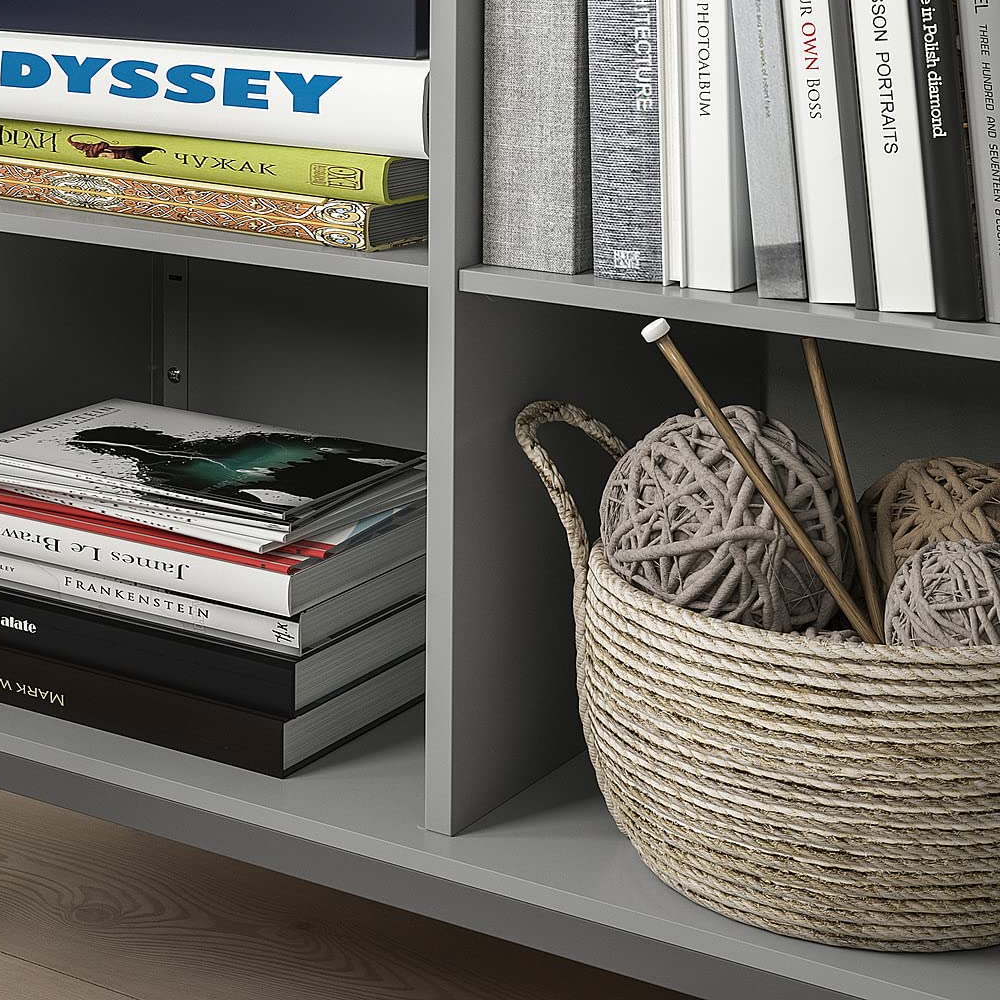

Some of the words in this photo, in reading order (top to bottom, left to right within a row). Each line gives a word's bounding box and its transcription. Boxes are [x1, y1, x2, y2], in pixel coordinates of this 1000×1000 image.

[922, 8, 936, 22] in
[696, 2, 711, 117] PHOTOALBUM
[801, 22, 819, 70] OWN
[922, 24, 940, 68] Polish
[979, 23, 990, 56] THREE
[806, 78, 822, 119] BOSS
[875, 51, 899, 154] PORTRAITS
[926, 70, 947, 138] diamond
[981, 61, 995, 111] HUNDRED
[987, 115, 997, 139] AND
[173, 152, 277, 176] ЧУЖАК
[70, 541, 101, 562] Le
[110, 551, 190, 581] James
[63, 575, 210, 619] FRANKENSTEIN
[15, 682, 65, 707] MARK
